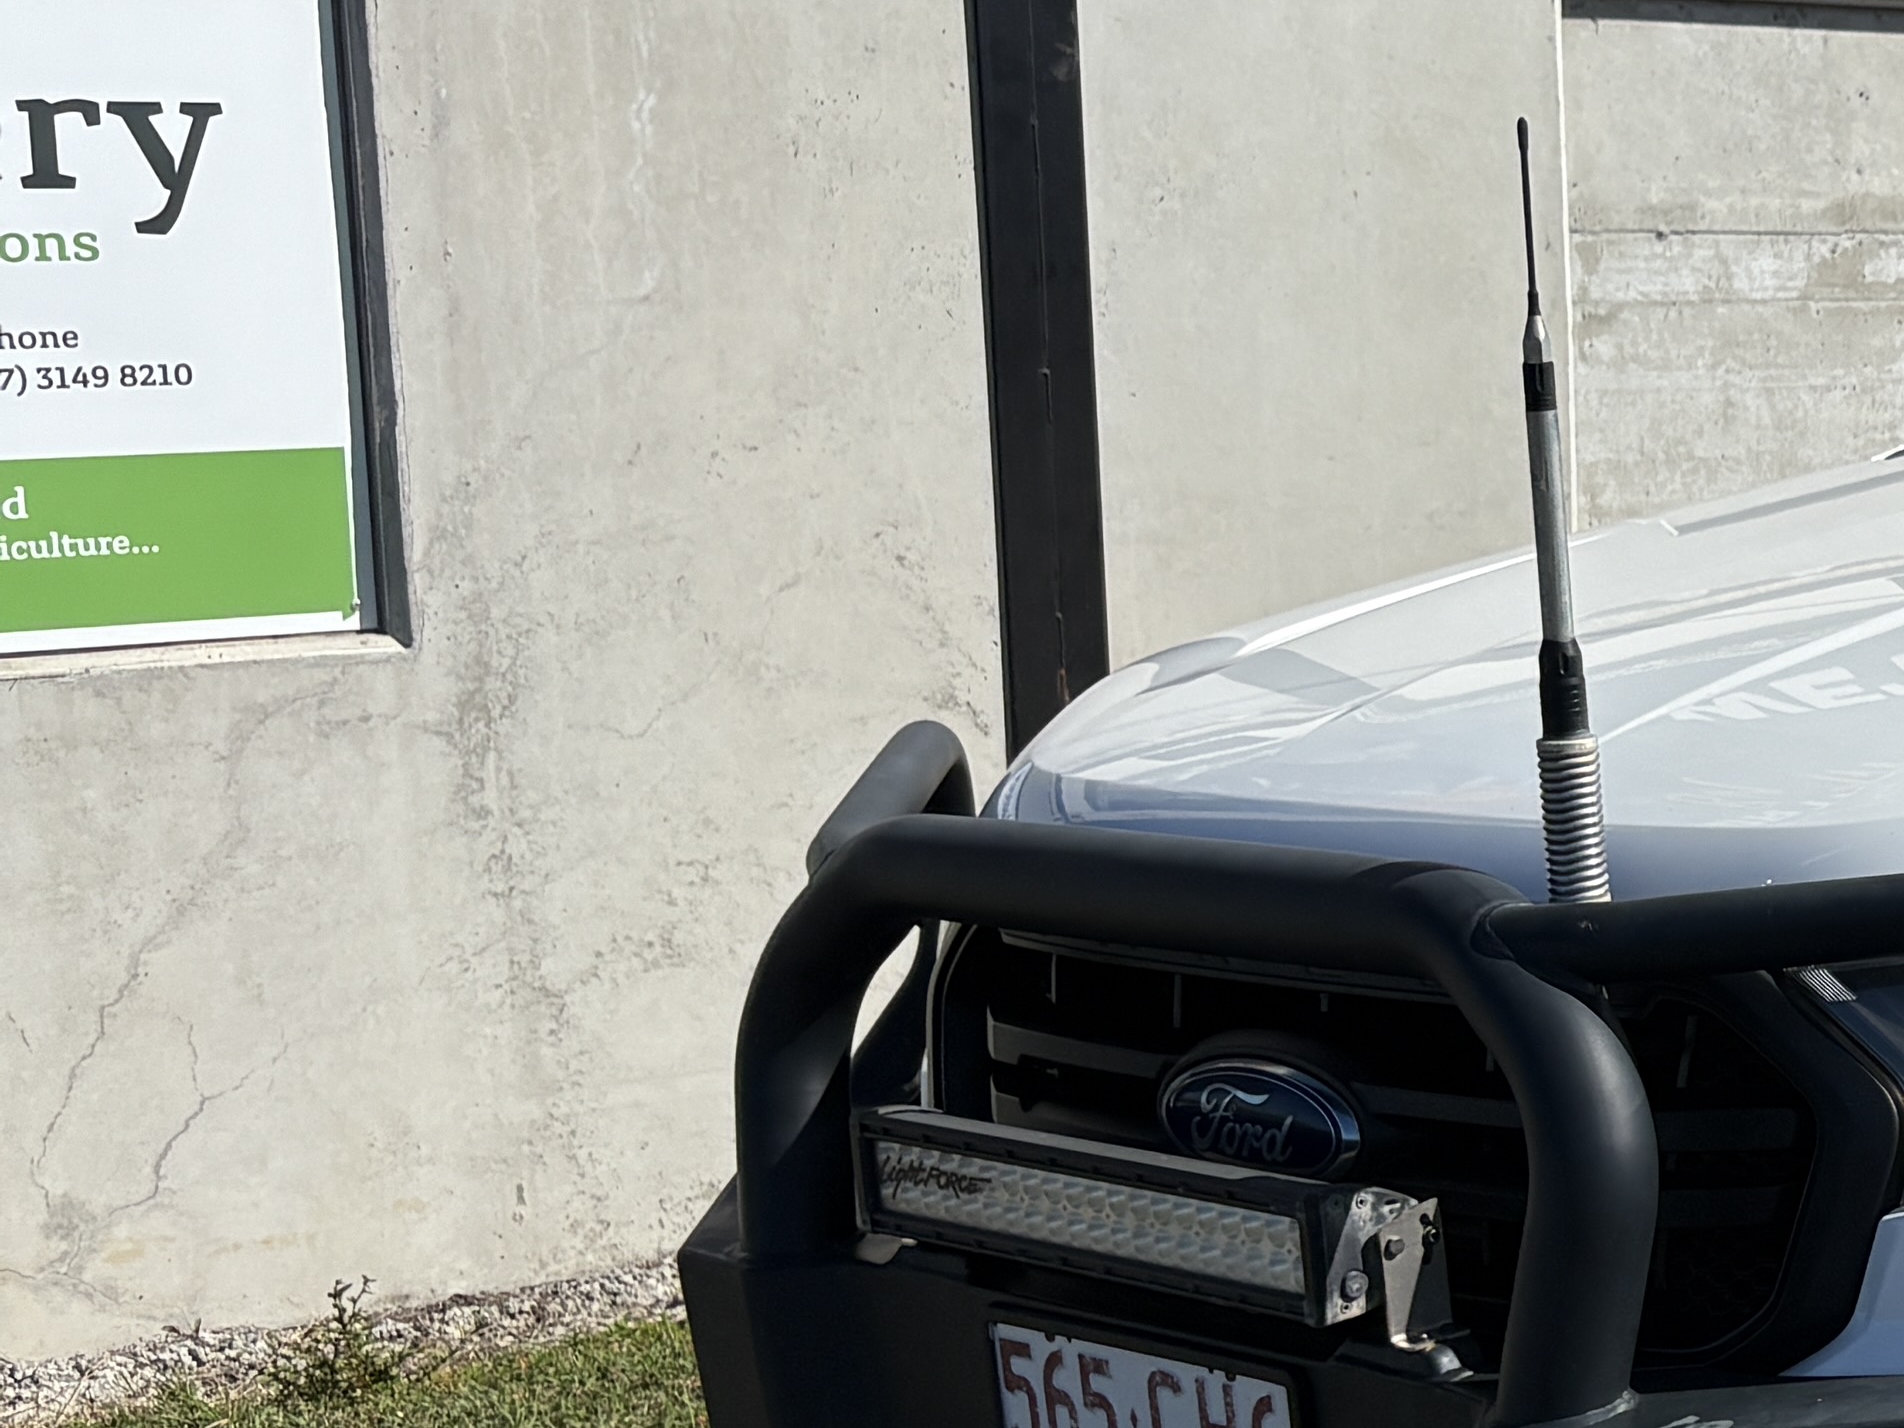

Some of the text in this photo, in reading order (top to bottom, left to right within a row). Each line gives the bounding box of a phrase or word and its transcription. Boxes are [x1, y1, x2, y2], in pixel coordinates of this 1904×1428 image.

[16, 99, 223, 235] ry
[36, 366, 109, 390] 3149
[119, 363, 193, 388] 8210
[1190, 1083, 1294, 1163] Ford
